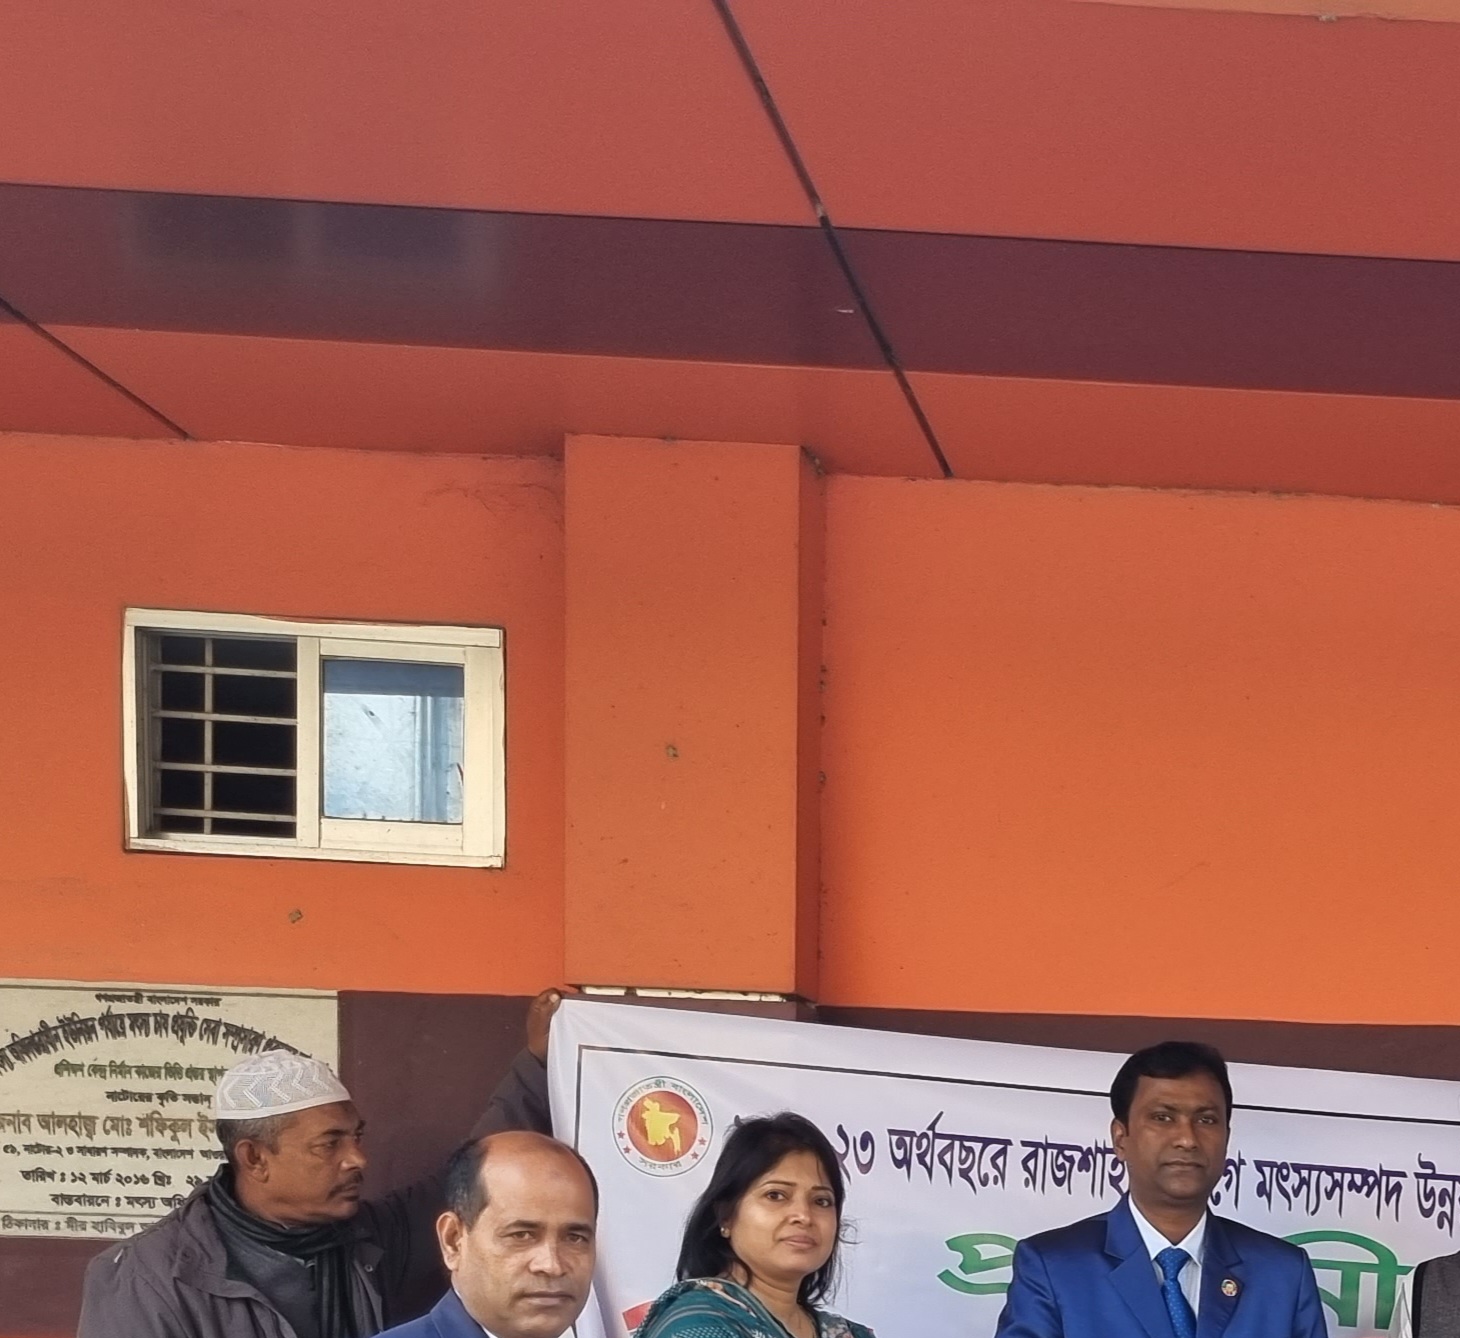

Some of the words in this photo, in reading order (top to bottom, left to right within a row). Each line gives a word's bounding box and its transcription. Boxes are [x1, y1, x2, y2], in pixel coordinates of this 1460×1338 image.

[103, 1115, 133, 1138] মোঃ
[135, 1110, 195, 1145] শফিকুল
[70, 1172, 87, 1185] ১২
[90, 1168, 113, 1185] মার্চ
[115, 1172, 150, 1187] ২০১৬
[887, 1110, 1014, 1195] অর্থবছরে
[1020, 1133, 1128, 1200] রাজশাহ
[1253, 1159, 1407, 1223] মৎস্যসম্পদ
[124, 1196, 158, 1209] মৎস্য
